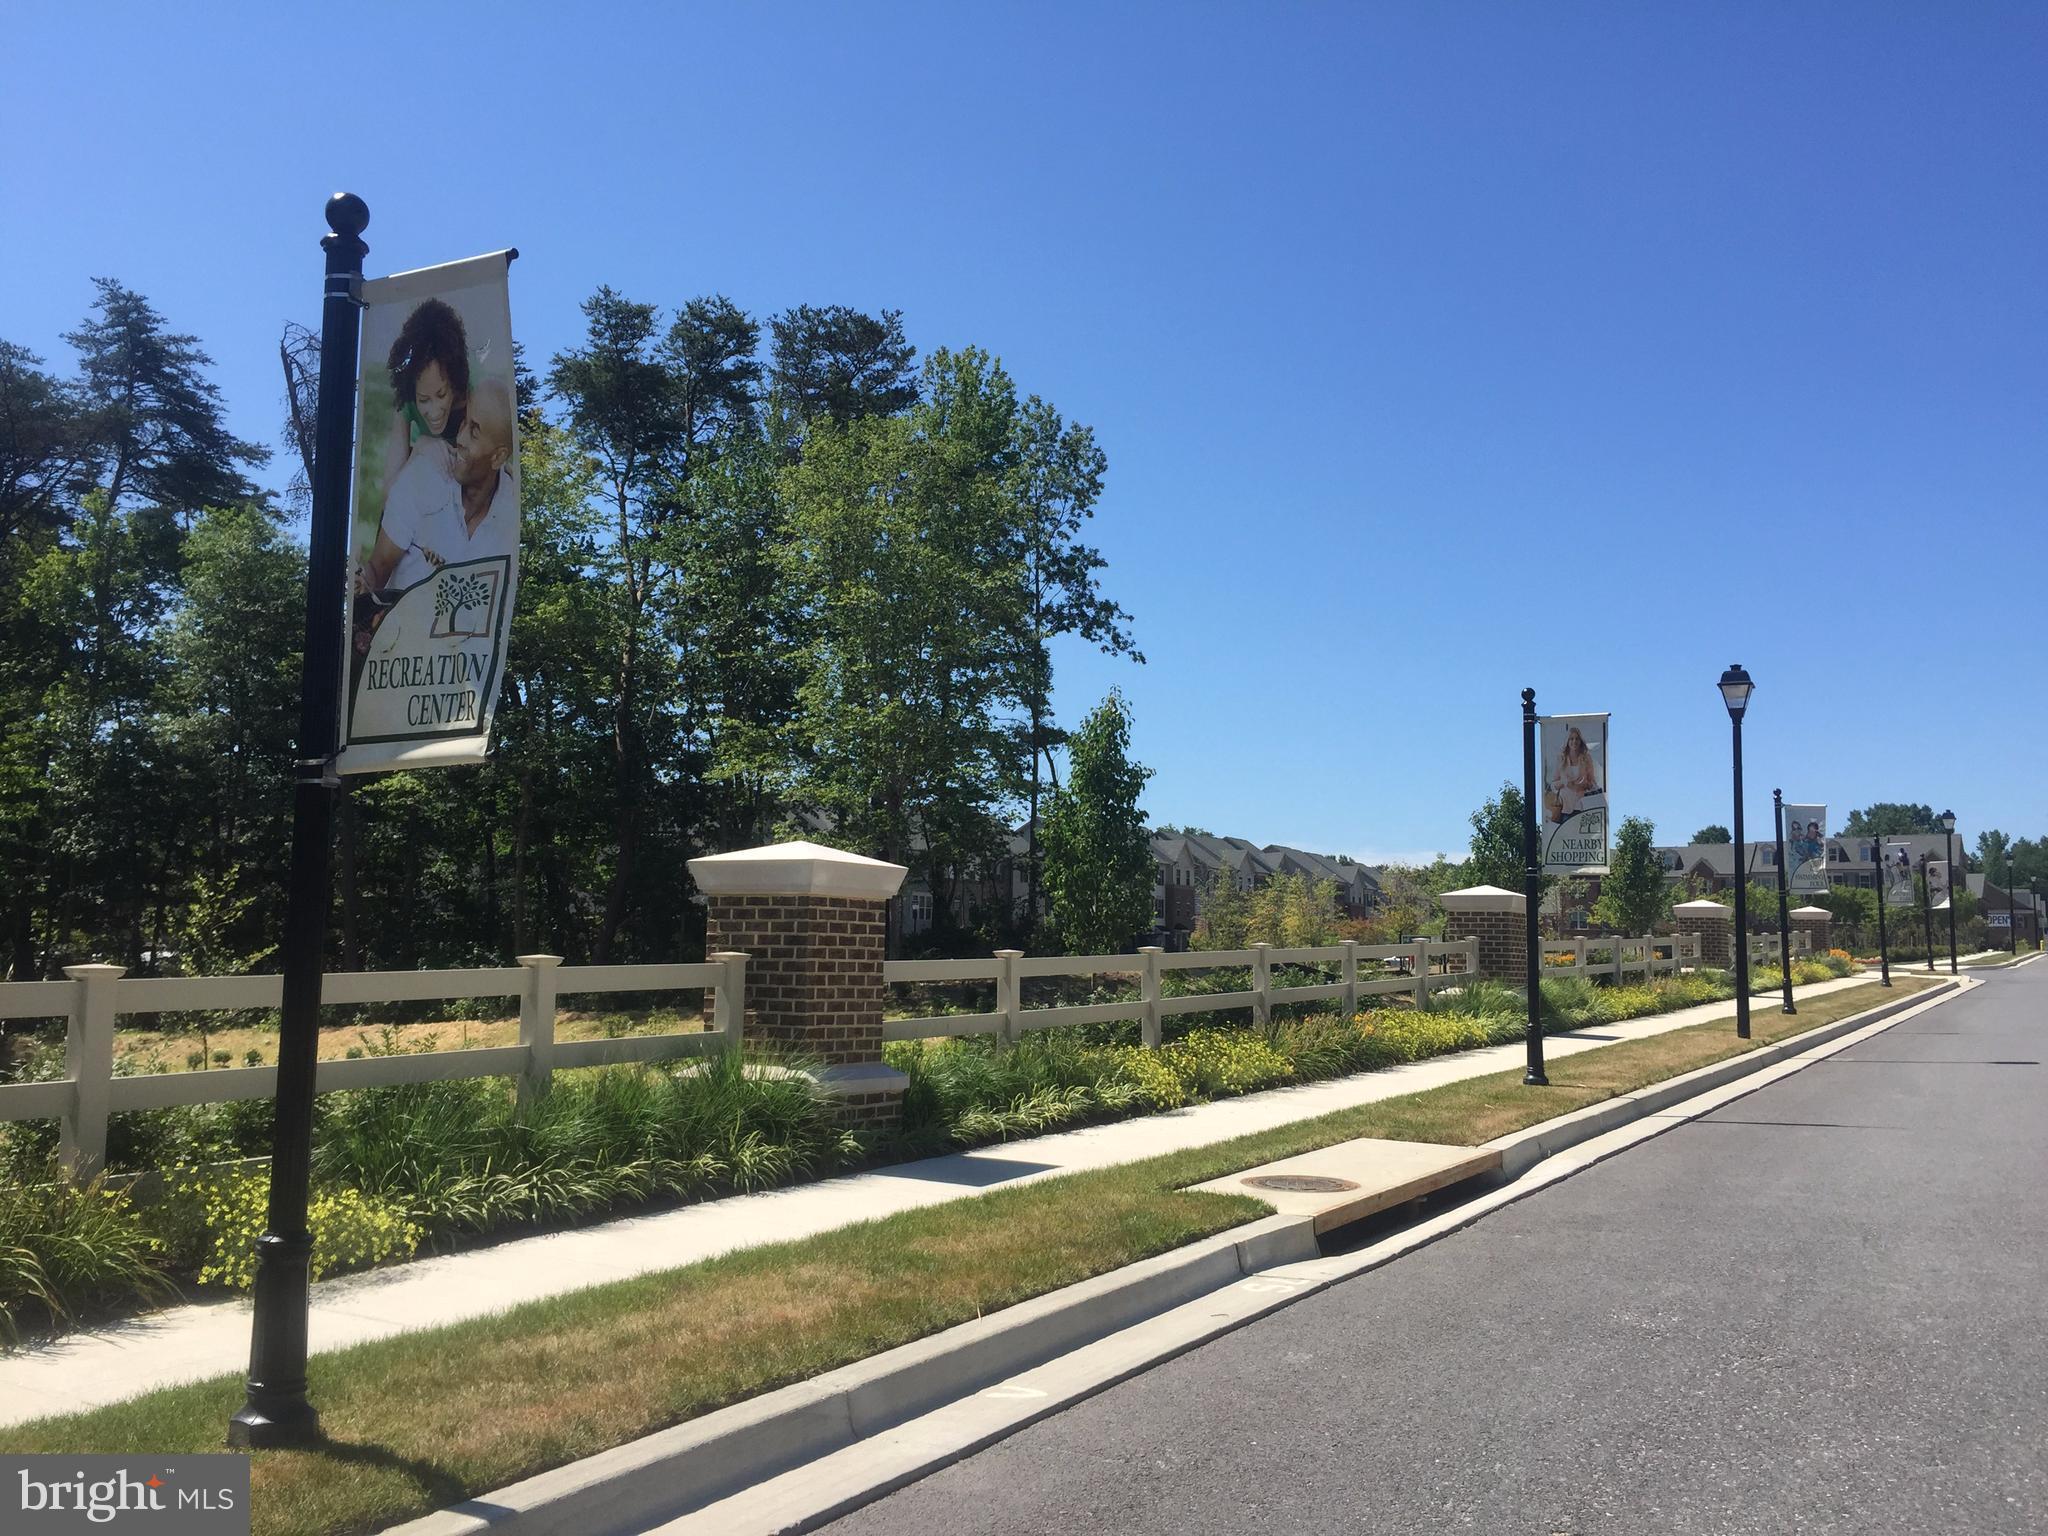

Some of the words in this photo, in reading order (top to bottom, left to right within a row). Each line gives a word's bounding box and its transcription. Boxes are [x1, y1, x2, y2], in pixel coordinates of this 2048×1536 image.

[367, 652, 488, 691] RECREATION
[407, 689, 476, 726] CENTER
[1551, 851, 1604, 862] SHOPPING
[1562, 839, 1604, 850] NEARBY
